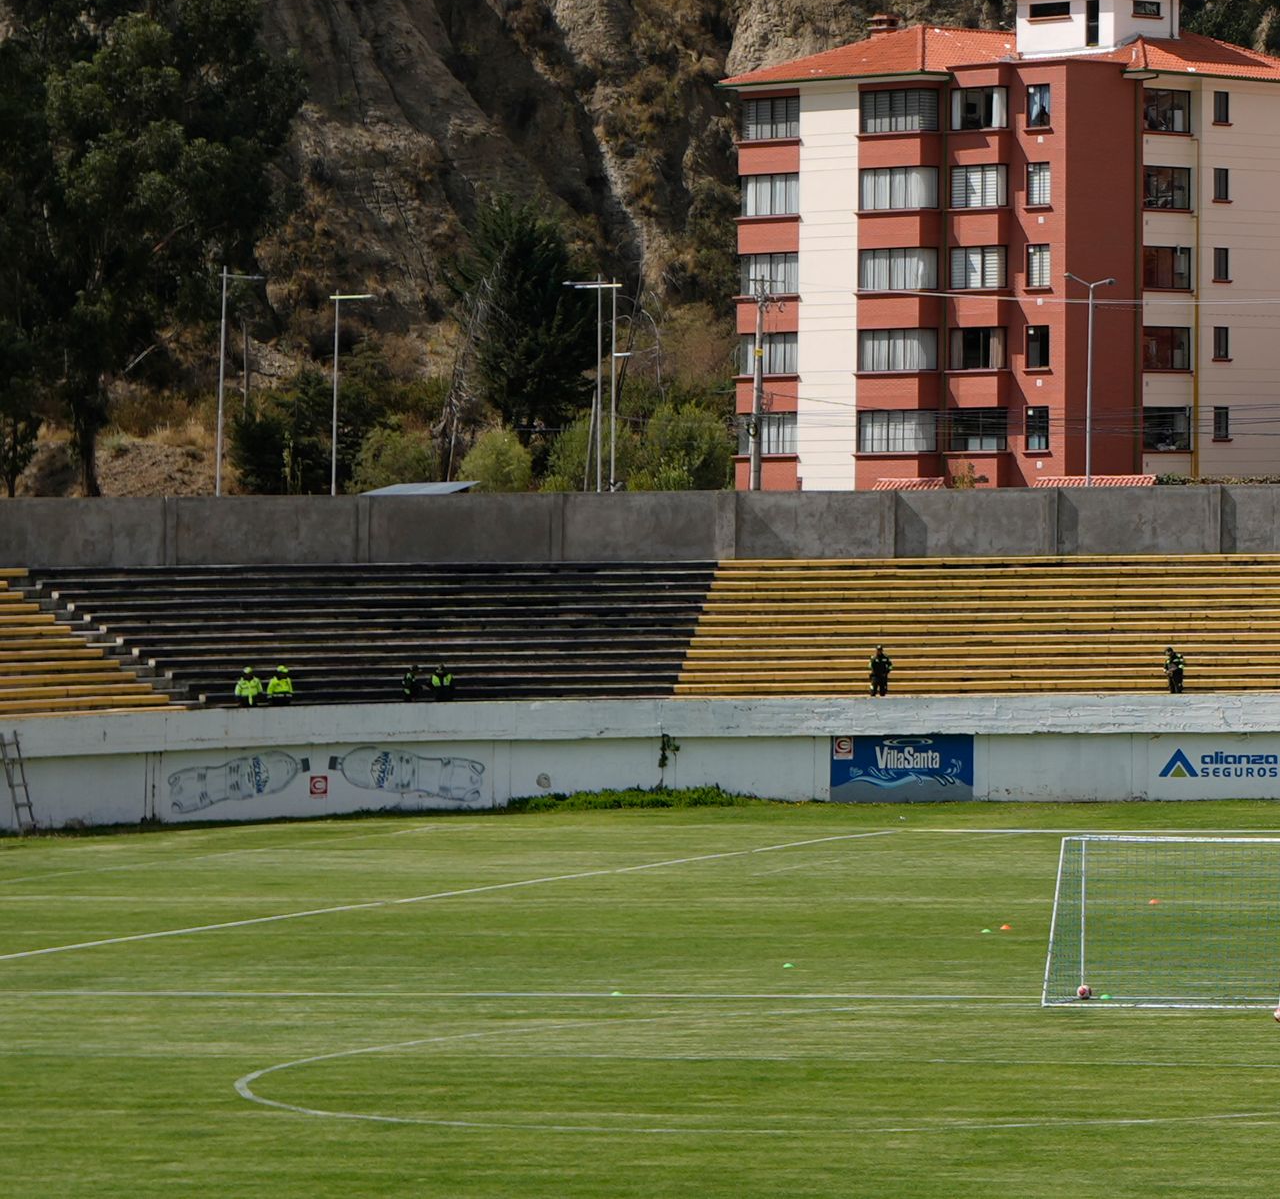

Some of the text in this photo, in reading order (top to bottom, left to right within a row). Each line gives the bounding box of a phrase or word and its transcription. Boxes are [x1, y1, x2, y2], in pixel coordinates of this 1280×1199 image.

[875, 746, 940, 769] VillaSanta
[1200, 751, 1278, 764] alianza
[1200, 767, 1278, 778] SEGUROS
